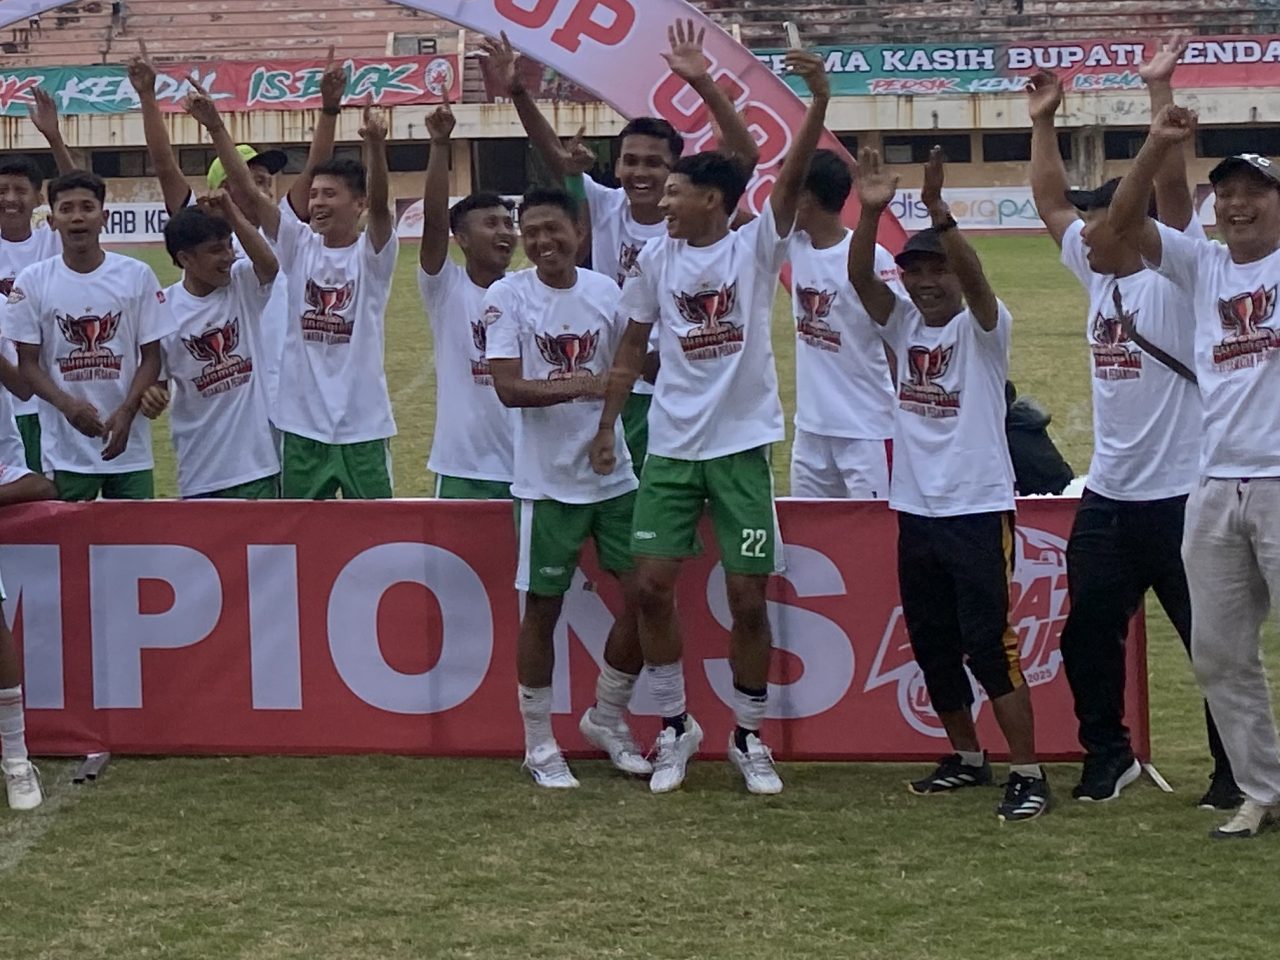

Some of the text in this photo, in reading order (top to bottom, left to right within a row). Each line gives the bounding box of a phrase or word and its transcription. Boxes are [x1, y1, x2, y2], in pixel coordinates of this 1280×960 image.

[417, 38, 437, 55] B
[754, 40, 1280, 74] EMA KASIH BUPATI ENDA
[247, 66, 293, 106] IS
[740, 528, 769, 558] 22
[1027, 669, 1052, 683] 2025
